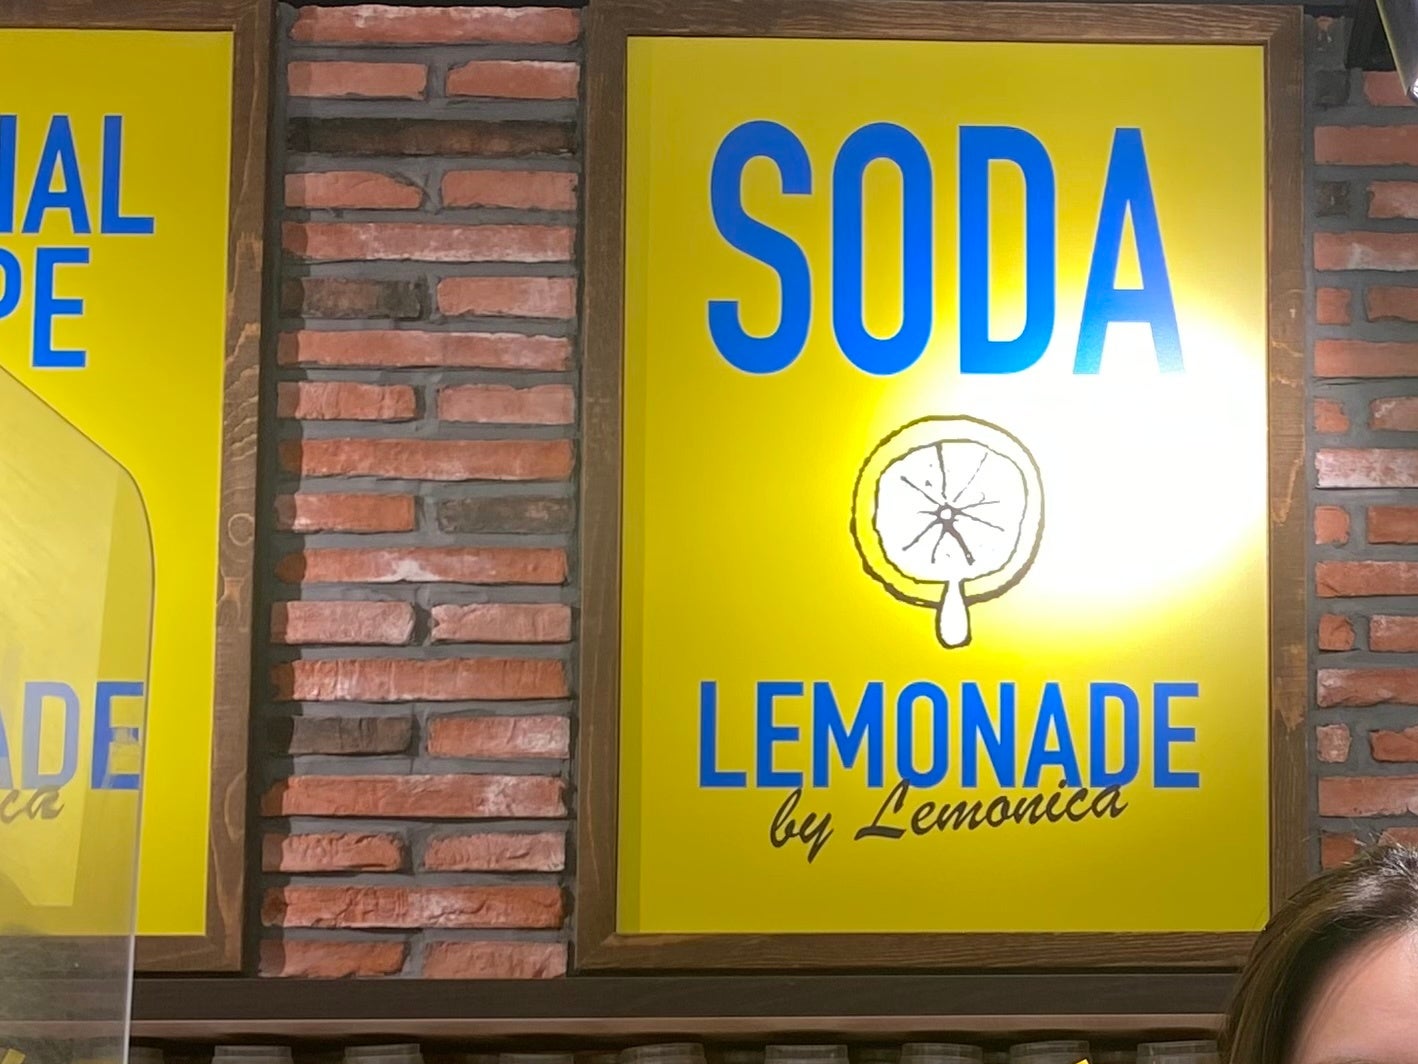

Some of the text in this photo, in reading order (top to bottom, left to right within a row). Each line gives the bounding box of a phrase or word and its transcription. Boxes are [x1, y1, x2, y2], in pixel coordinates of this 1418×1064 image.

[707, 119, 1185, 375] SODA
[0, 681, 143, 789] DE
[698, 681, 1201, 789] LEMONADE
[769, 778, 1129, 862] by Lemonica
